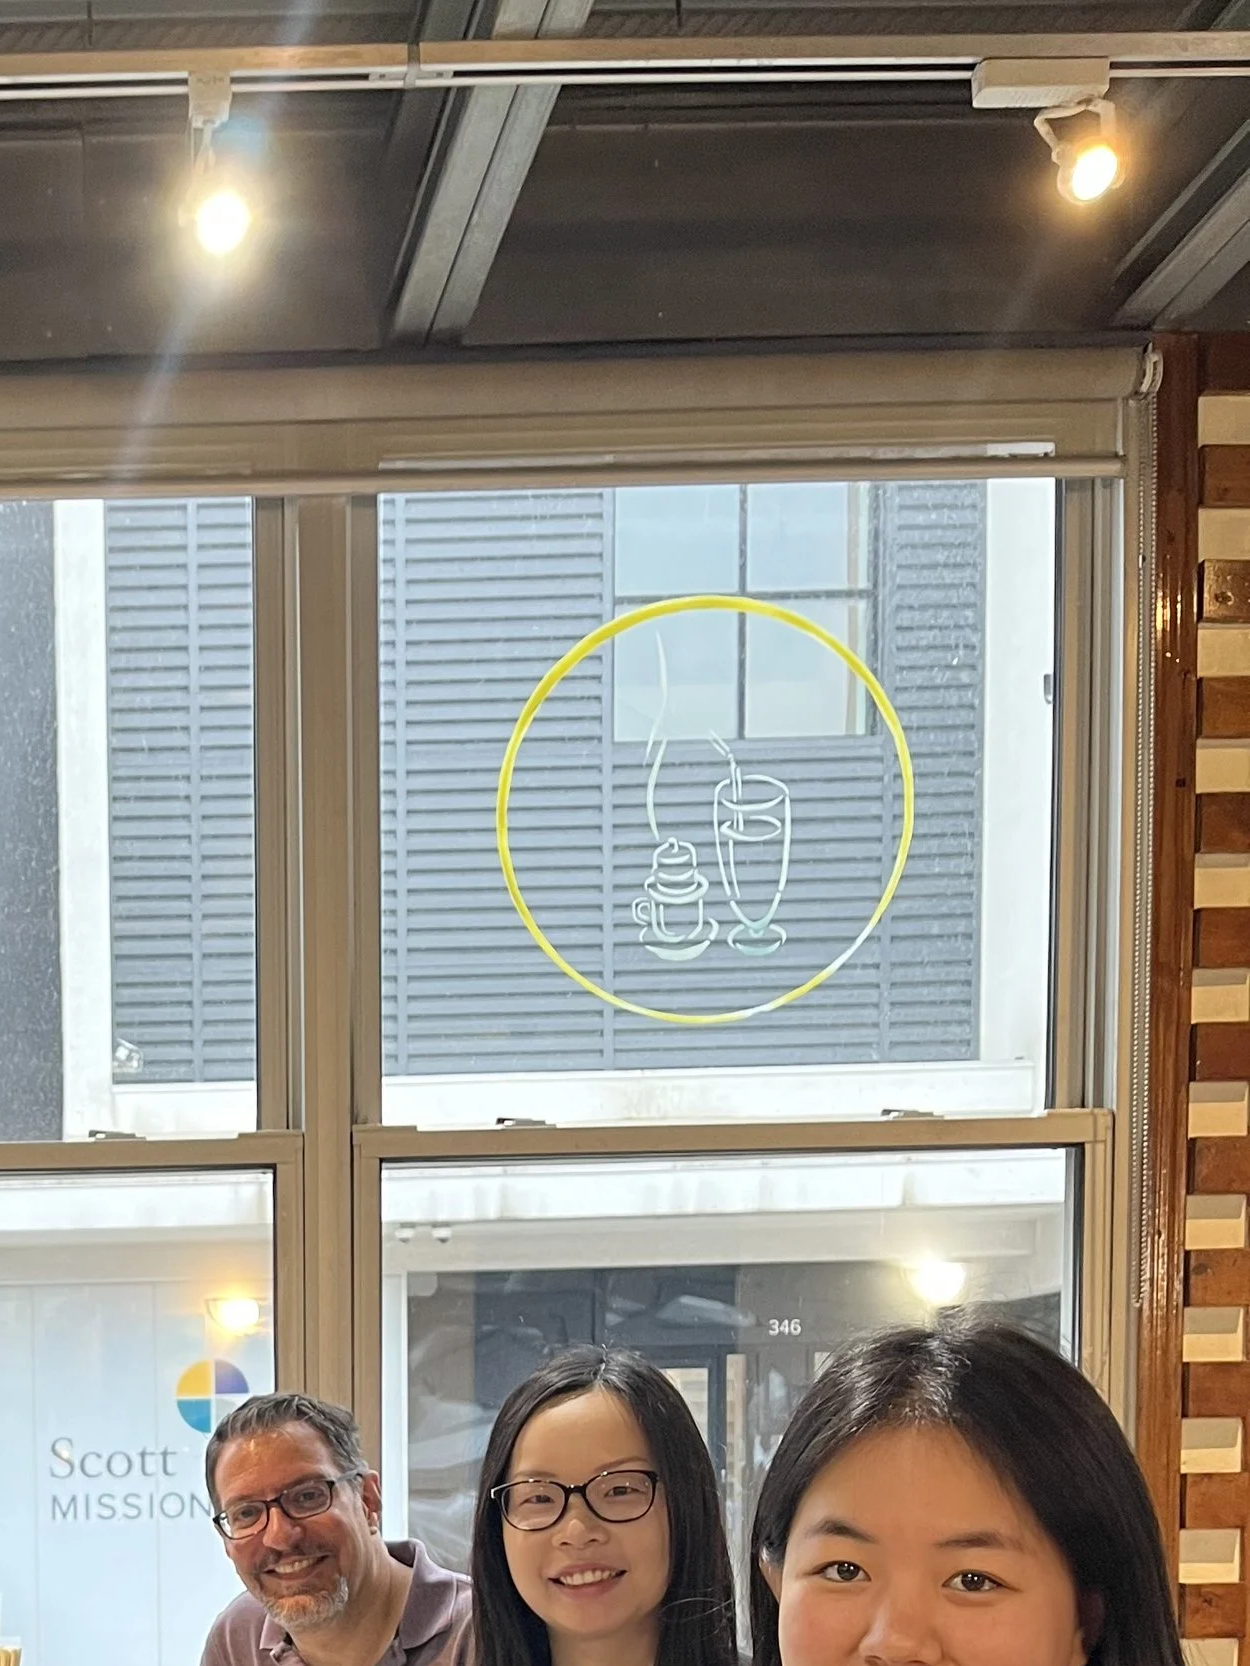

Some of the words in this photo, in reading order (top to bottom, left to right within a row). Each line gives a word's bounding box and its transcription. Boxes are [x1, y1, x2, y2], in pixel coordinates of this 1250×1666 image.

[768, 1318, 802, 1336] 346
[50, 1436, 178, 1479] Scott
[51, 1491, 213, 1521] MISSION
